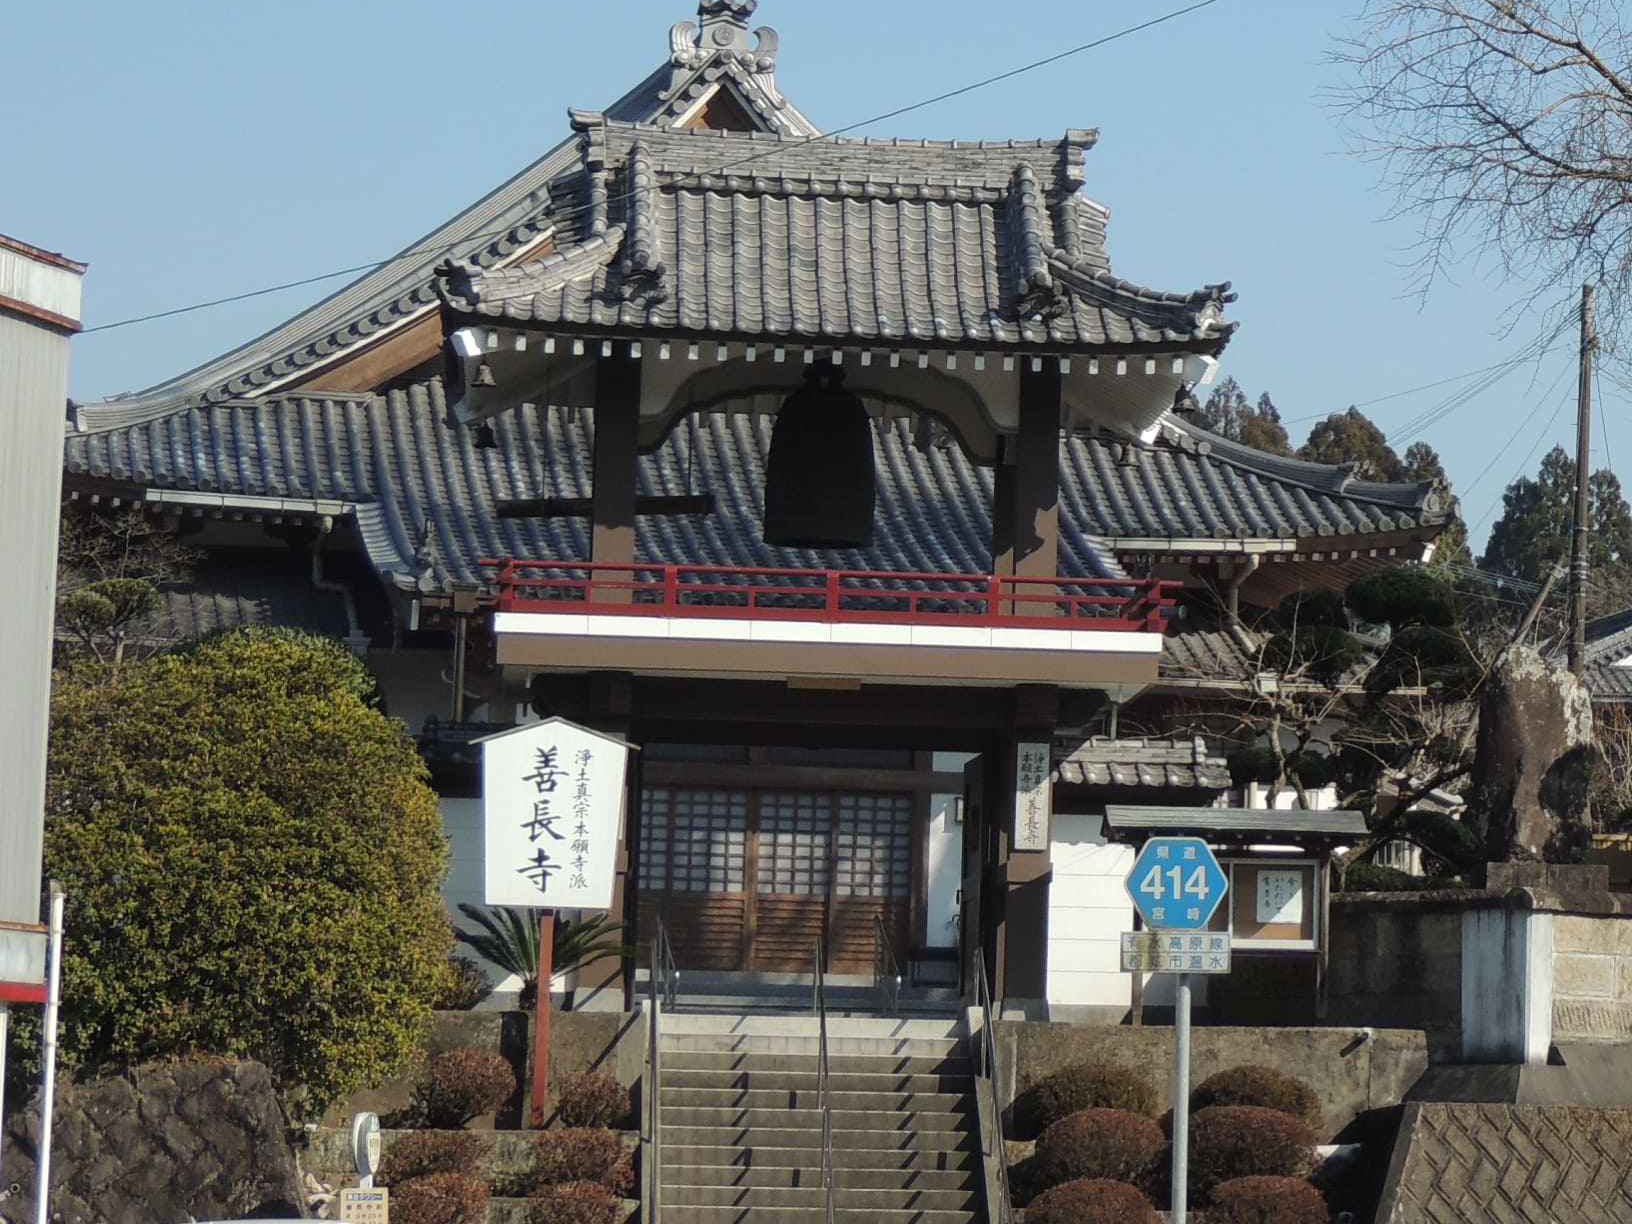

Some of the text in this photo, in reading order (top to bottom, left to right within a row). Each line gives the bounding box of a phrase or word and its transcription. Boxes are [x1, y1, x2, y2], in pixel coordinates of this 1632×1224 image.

[515, 745, 570, 894] 善長寺
[569, 748, 595, 889] 浄土真宗本願寺派
[1140, 864, 1210, 900] 414
